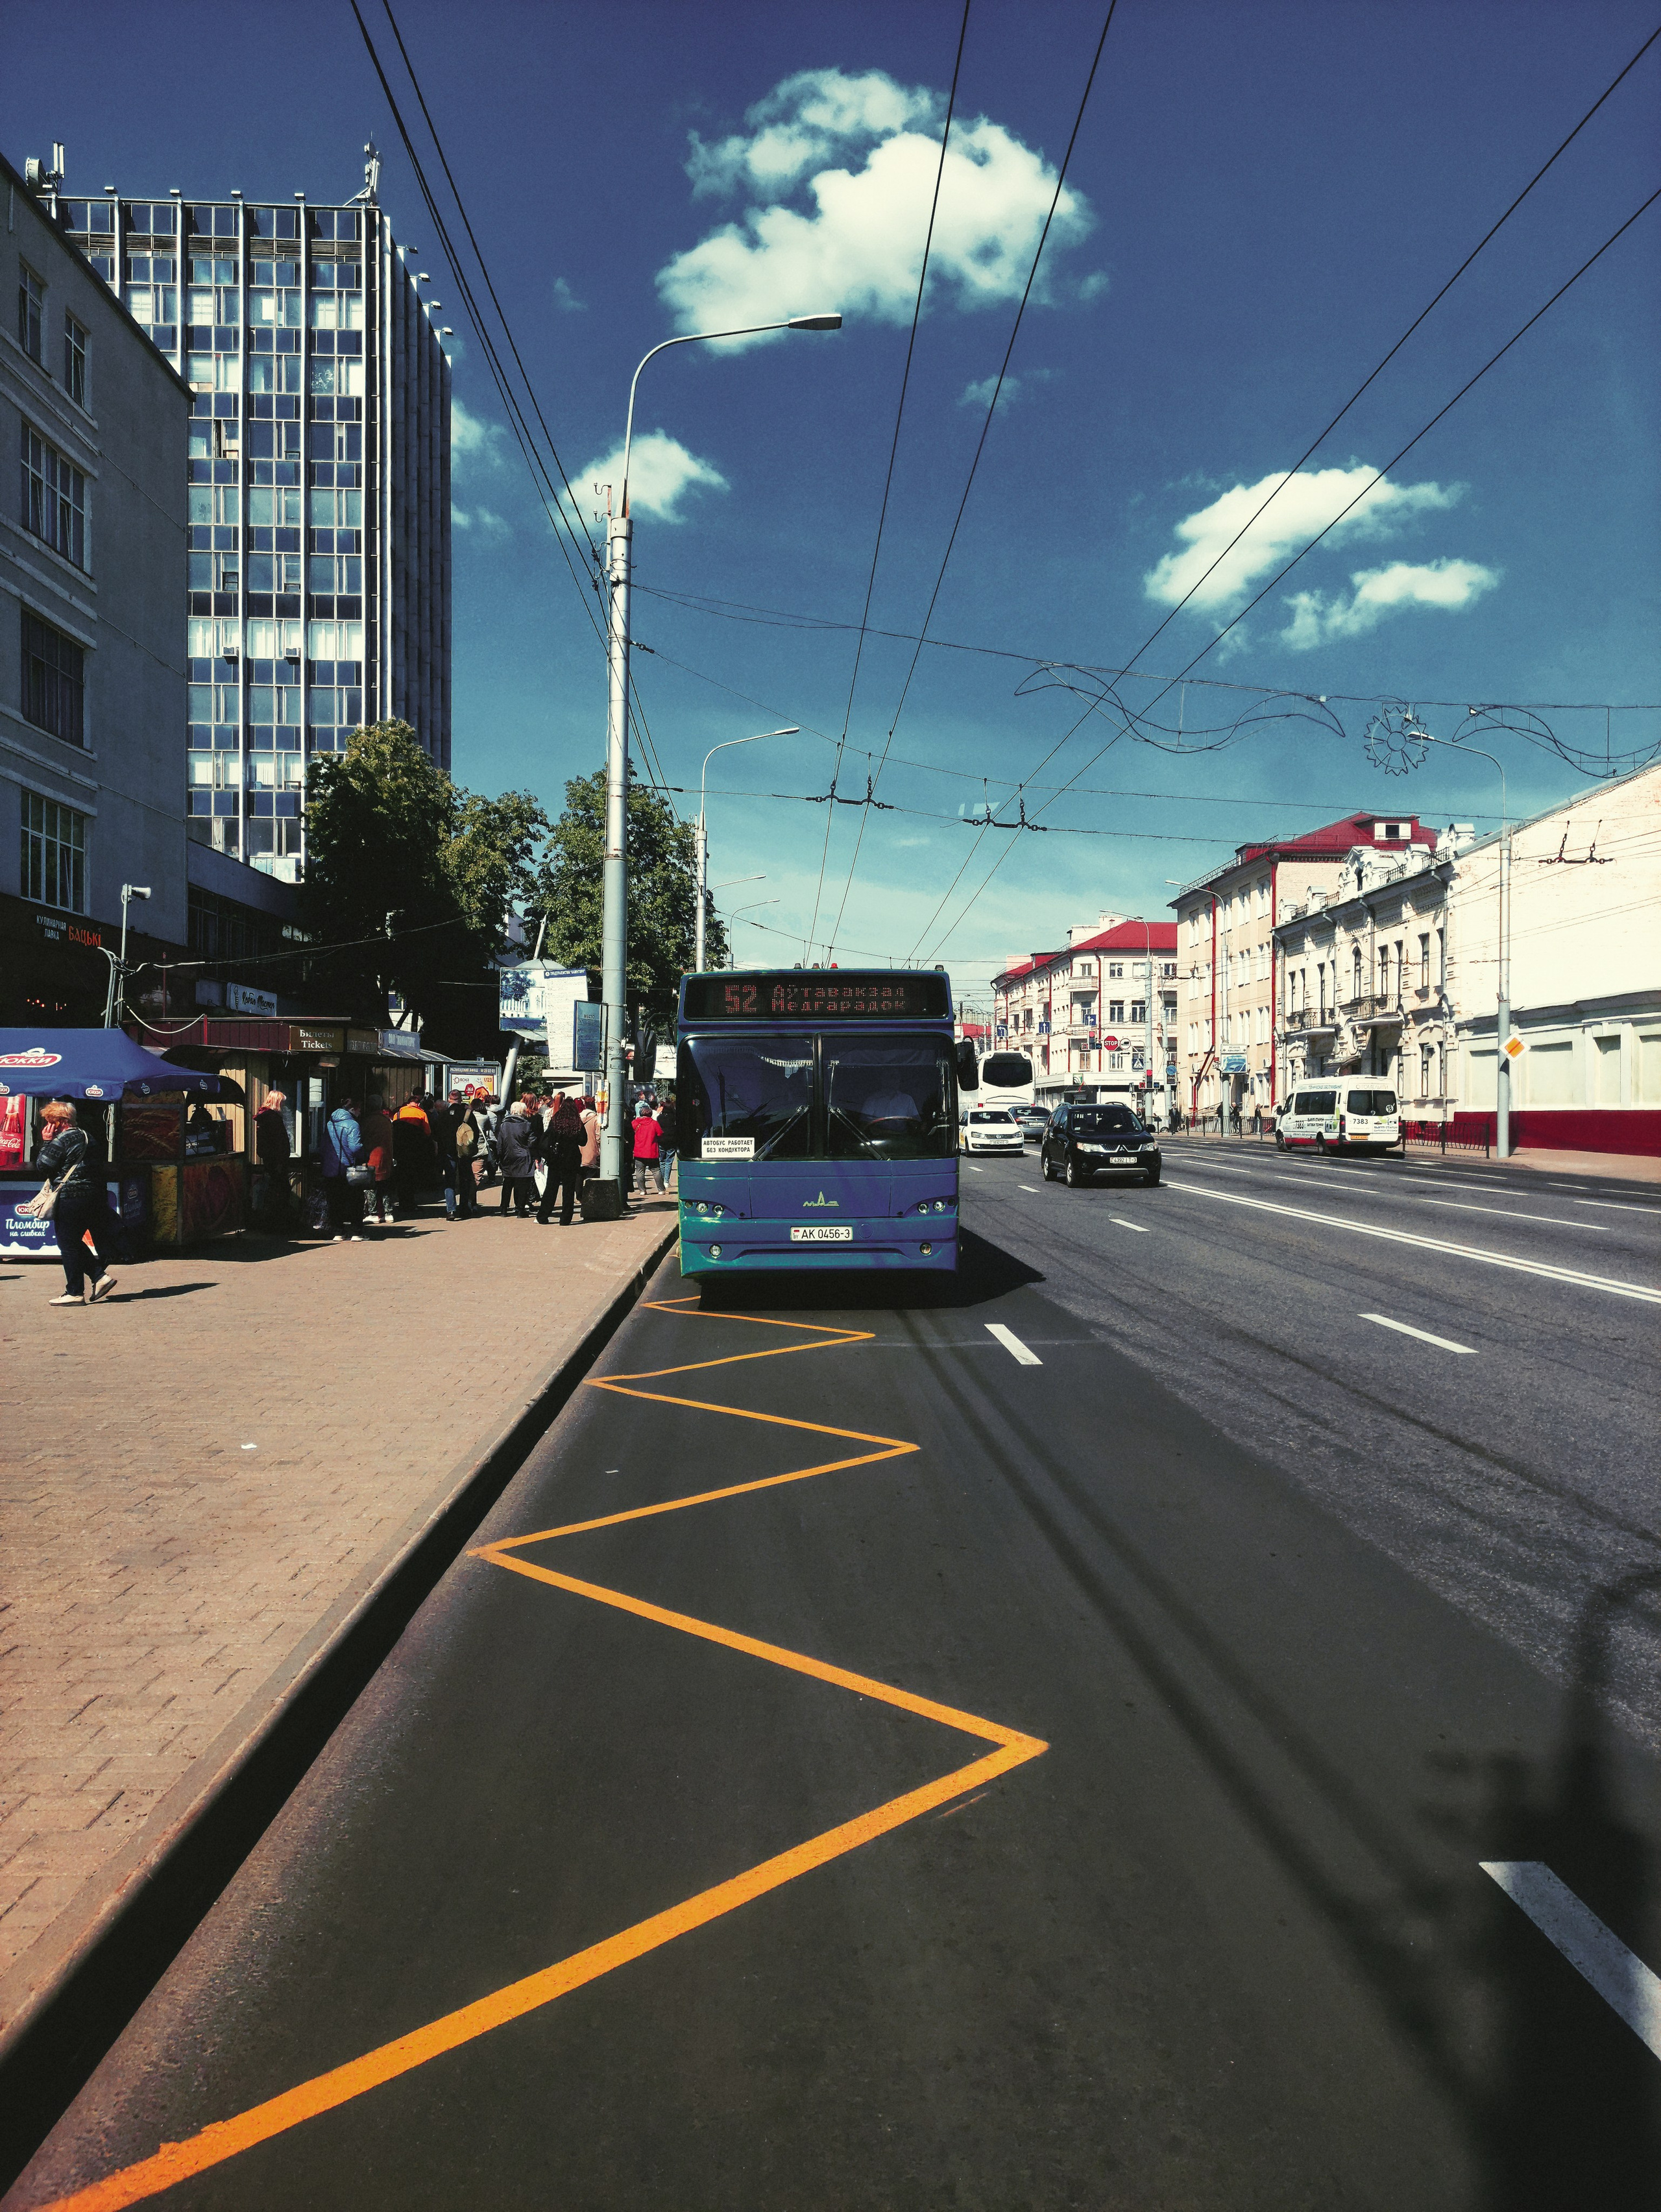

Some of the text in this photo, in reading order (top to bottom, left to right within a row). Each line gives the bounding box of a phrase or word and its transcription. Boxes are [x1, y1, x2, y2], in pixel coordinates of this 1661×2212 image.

[36, 915, 67, 931] КУЛИНАРНАЯ
[44, 929, 60, 940] ЛАВКА
[725, 984, 757, 1013] 52
[771, 999, 906, 1012] Медгарадок
[300, 1029, 334, 1038] Билеты
[301, 1040, 332, 1049] Tickets
[5, 1218, 50, 1231] Пломбир
[801, 1229, 816, 1239] AK
[818, 1229, 850, 1239] 0456-3
